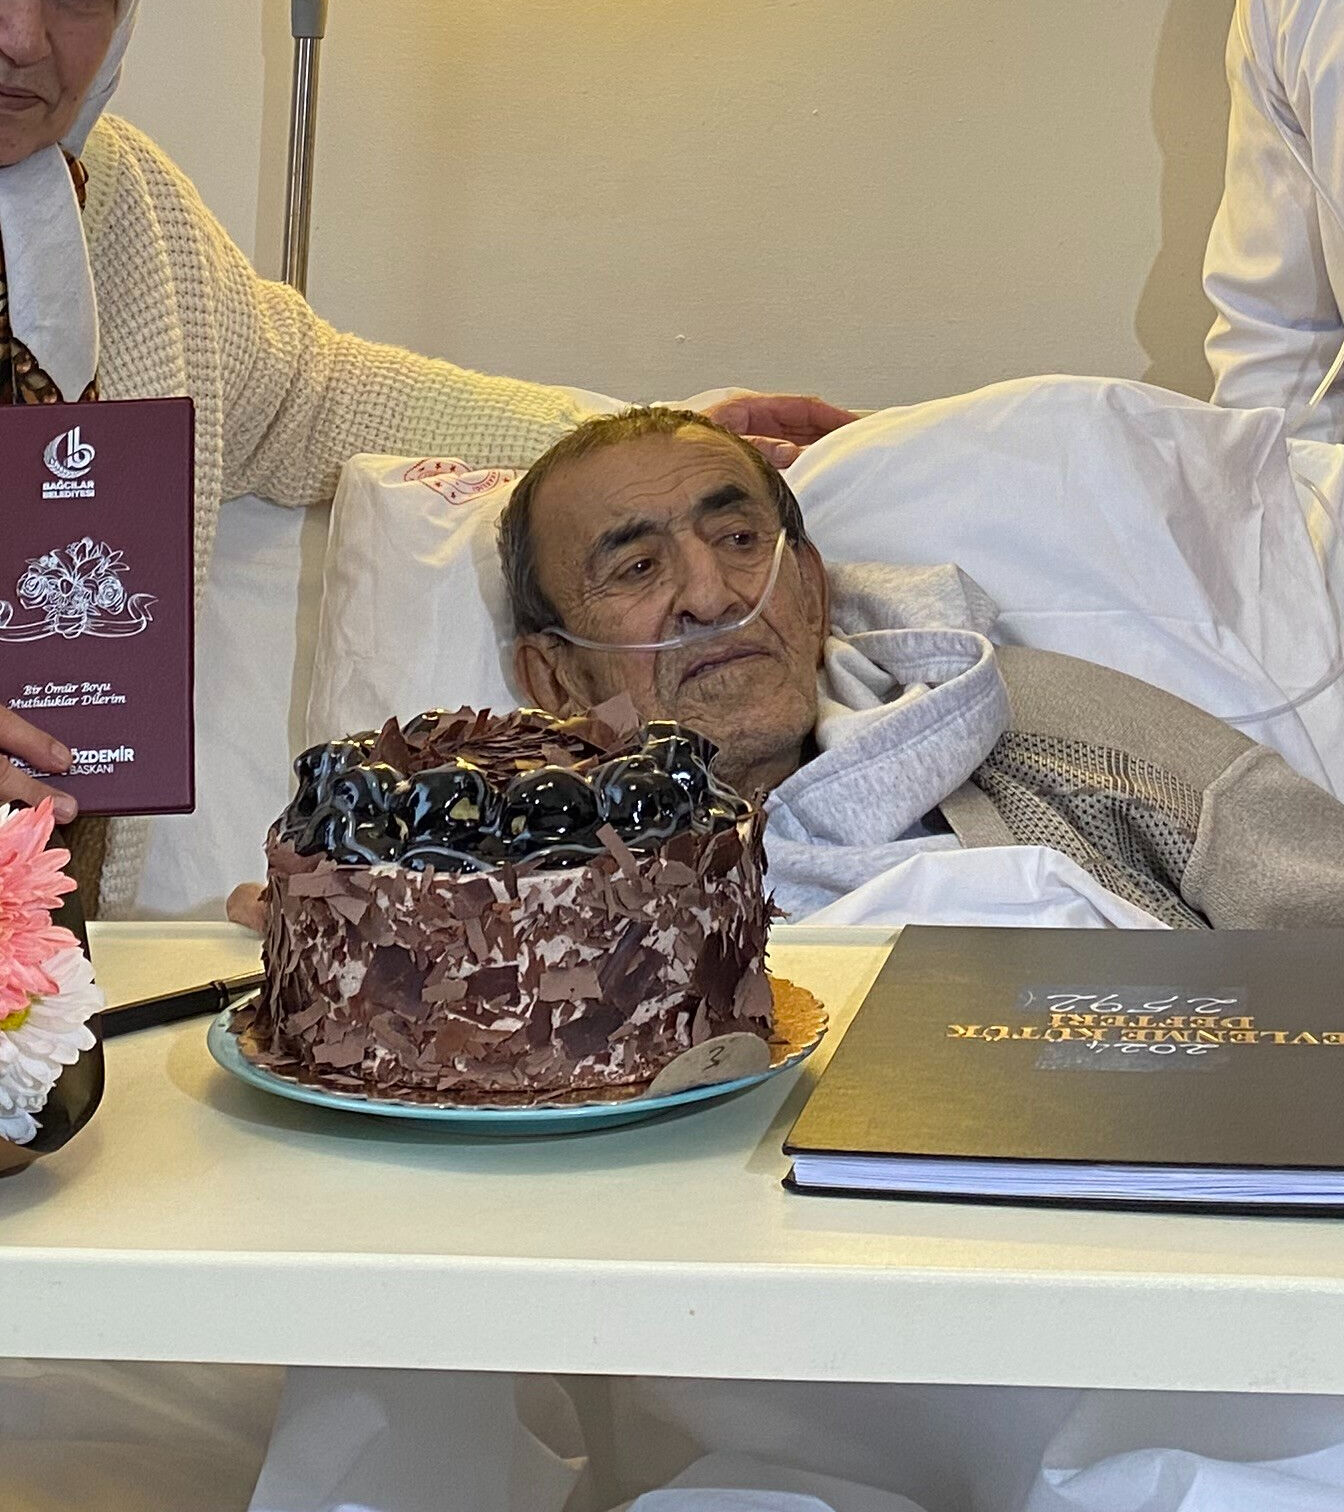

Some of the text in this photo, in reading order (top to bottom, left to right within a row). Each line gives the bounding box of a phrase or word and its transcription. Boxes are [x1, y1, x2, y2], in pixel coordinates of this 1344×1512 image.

[42, 479, 95, 490] BAĞCILAR
[23, 681, 111, 695] Bir Ömür Boyu
[7, 693, 126, 709] Mutluluklar Dilerim
[1046, 993, 1238, 1014] 2592
[1048, 1013, 1255, 1029] DEFTERİ
[947, 1023, 1109, 1042] KÜTÜK
[1086, 1040, 1220, 1055] 2024
